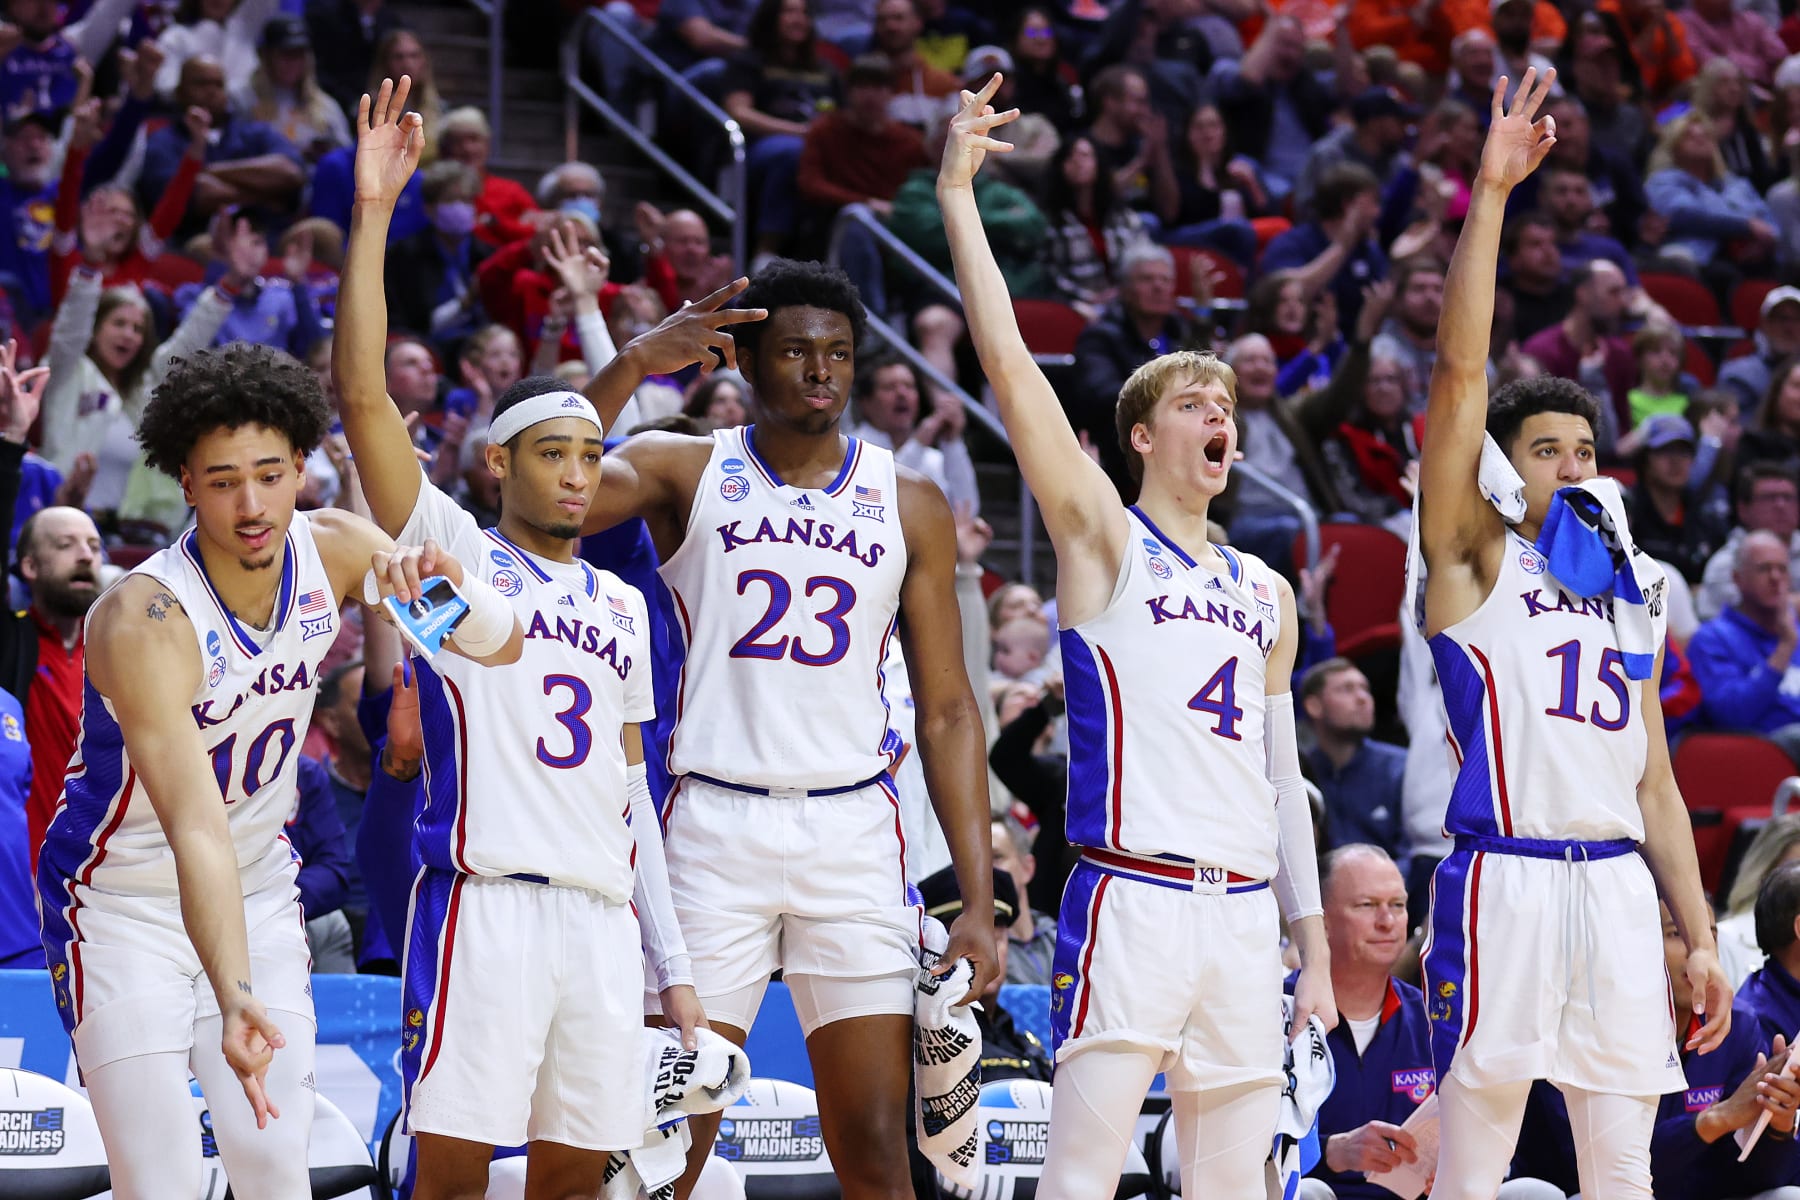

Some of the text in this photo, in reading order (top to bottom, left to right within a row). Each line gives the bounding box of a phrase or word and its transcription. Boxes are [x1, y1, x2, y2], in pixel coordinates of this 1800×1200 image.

[723, 484, 738, 493] 125
[716, 516, 886, 568] KANSAS
[1521, 557, 1534, 567] 125
[495, 577, 510, 588] 125
[729, 568, 857, 667] 23
[524, 609, 632, 681] ANSAS
[1187, 655, 1244, 741] 4
[1545, 639, 1630, 732] 15
[535, 673, 593, 769] 3
[207, 717, 296, 805] 10
[1200, 867, 1223, 885] KU
[930, 1024, 958, 1045] THE
[926, 1033, 974, 1066] FOUR
[671, 1050, 699, 1087] FOU
[1394, 1072, 1435, 1086] KANSA
[929, 1078, 972, 1113] MARCH
[942, 1080, 981, 1121] MADNE
[0, 1112, 33, 1131] RCH
[735, 1120, 793, 1138] MARCH
[1003, 1122, 1048, 1140] MARC
[0, 1130, 64, 1149] ADNESS
[744, 1136, 822, 1156] MADNESS
